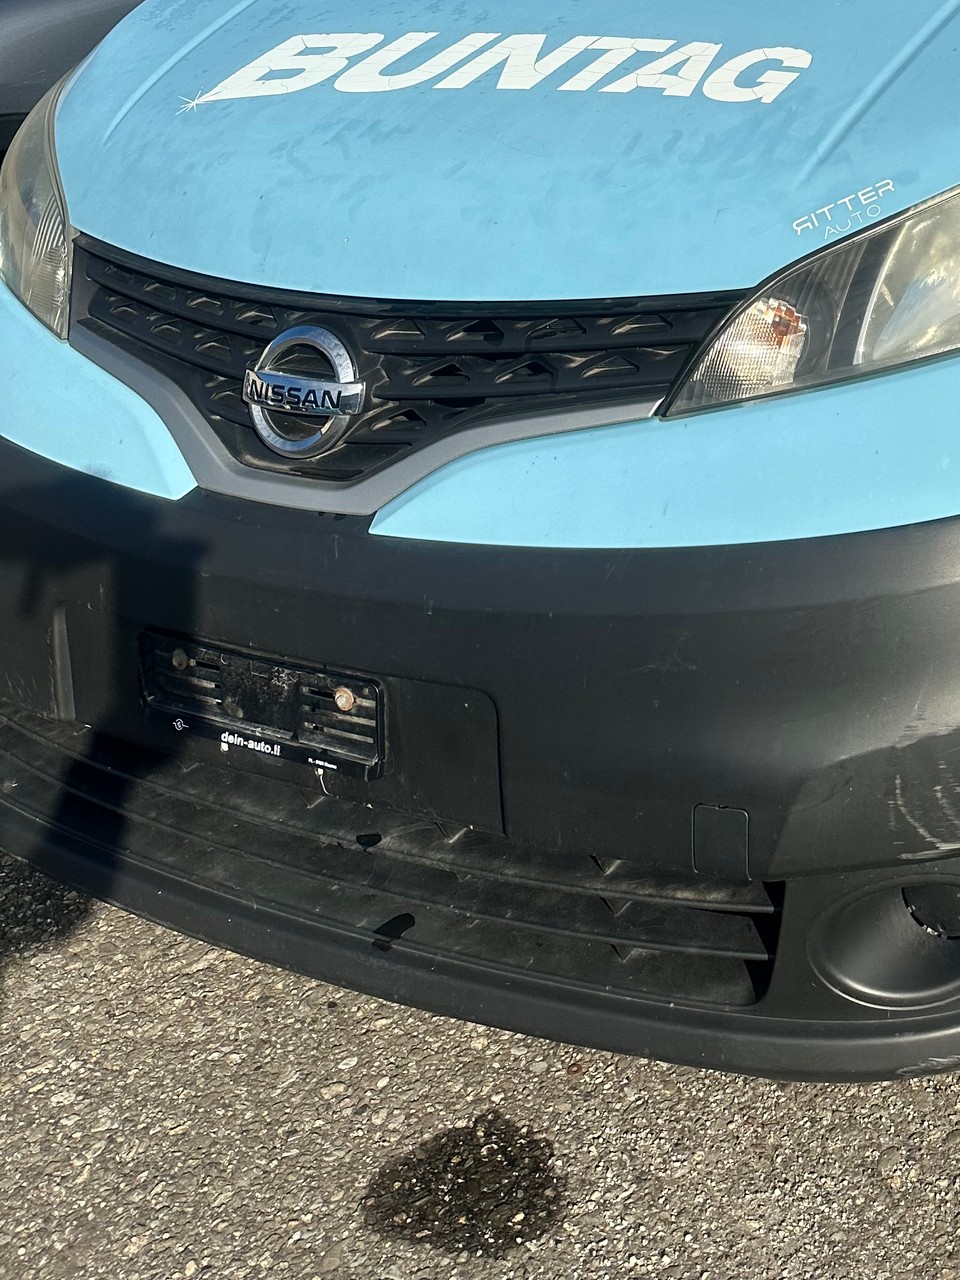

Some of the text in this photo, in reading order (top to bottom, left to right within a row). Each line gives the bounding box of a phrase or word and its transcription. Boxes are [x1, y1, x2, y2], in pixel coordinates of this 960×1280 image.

[195, 32, 813, 104] BUNTAG
[824, 204, 881, 239] AUTO
[250, 380, 342, 409] NISSAN
[221, 731, 281, 756] dein-auto.li
